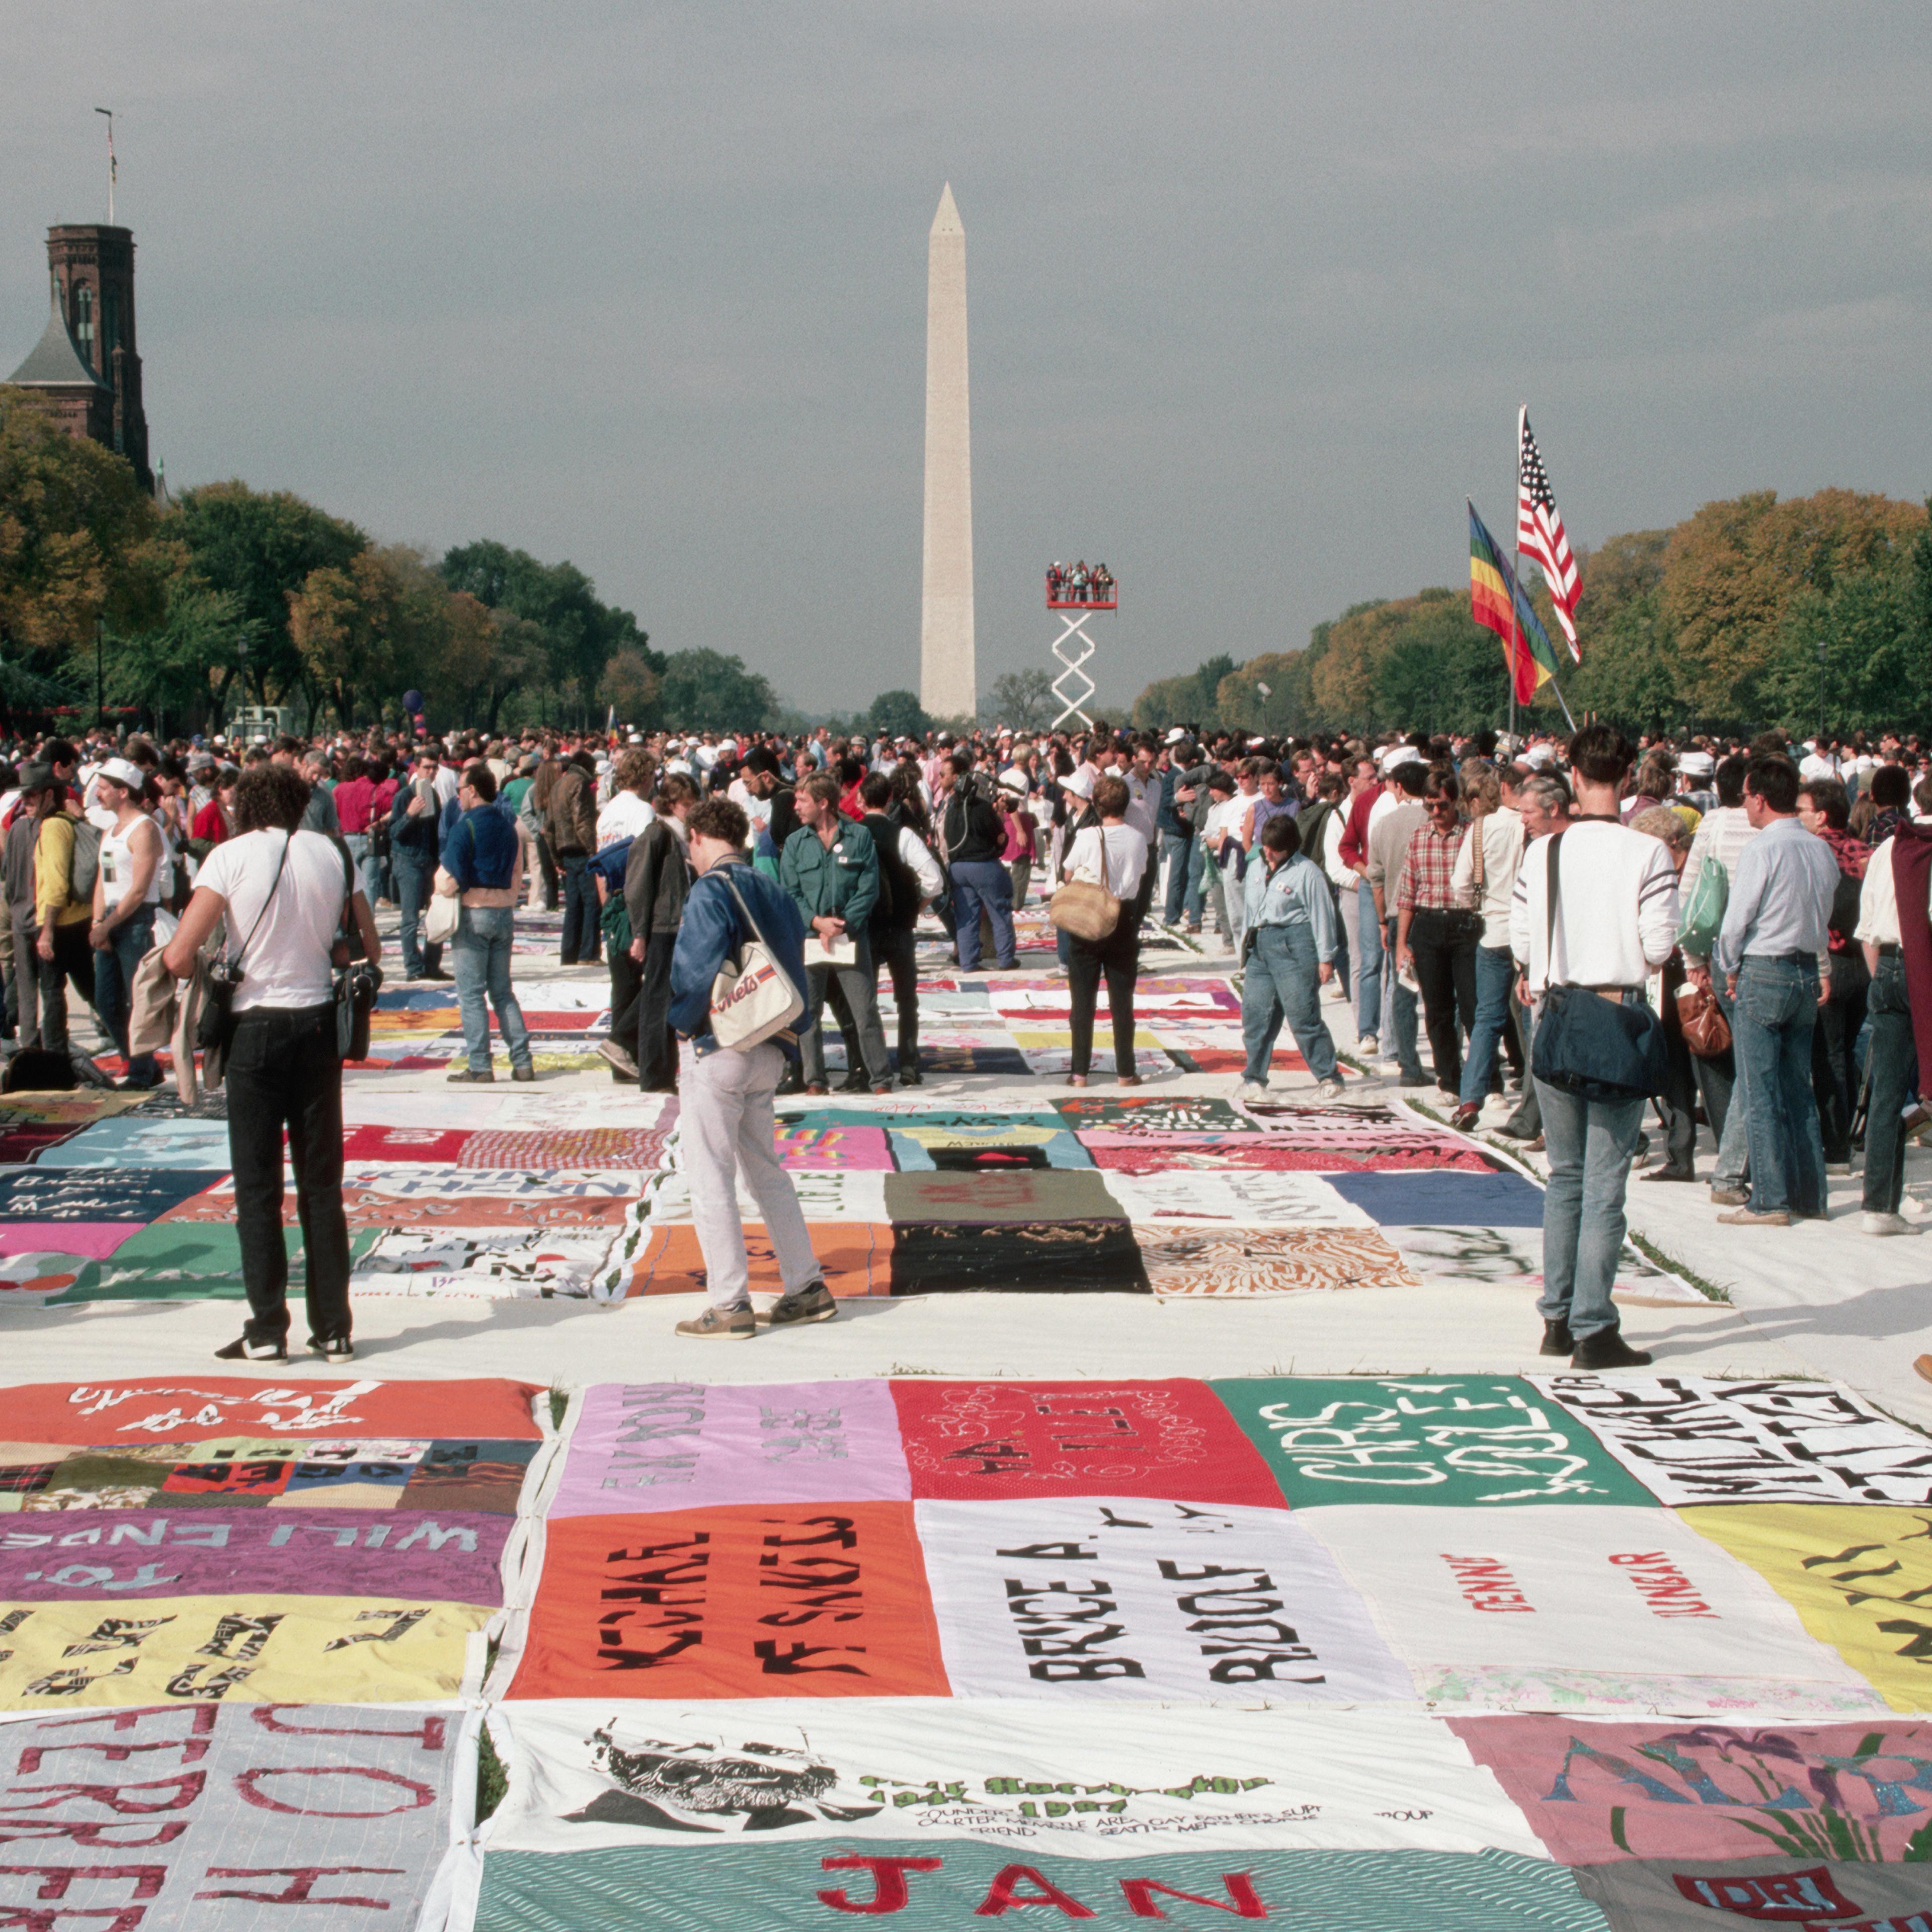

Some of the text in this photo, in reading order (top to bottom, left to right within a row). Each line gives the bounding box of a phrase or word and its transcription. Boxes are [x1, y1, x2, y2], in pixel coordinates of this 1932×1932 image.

[1258, 1402, 1448, 1485] CHRIS
[1004, 1578, 1146, 1682] BRUCE
[1148, 1815, 1187, 1826] GAY
[816, 1856, 1268, 1919] JAN
